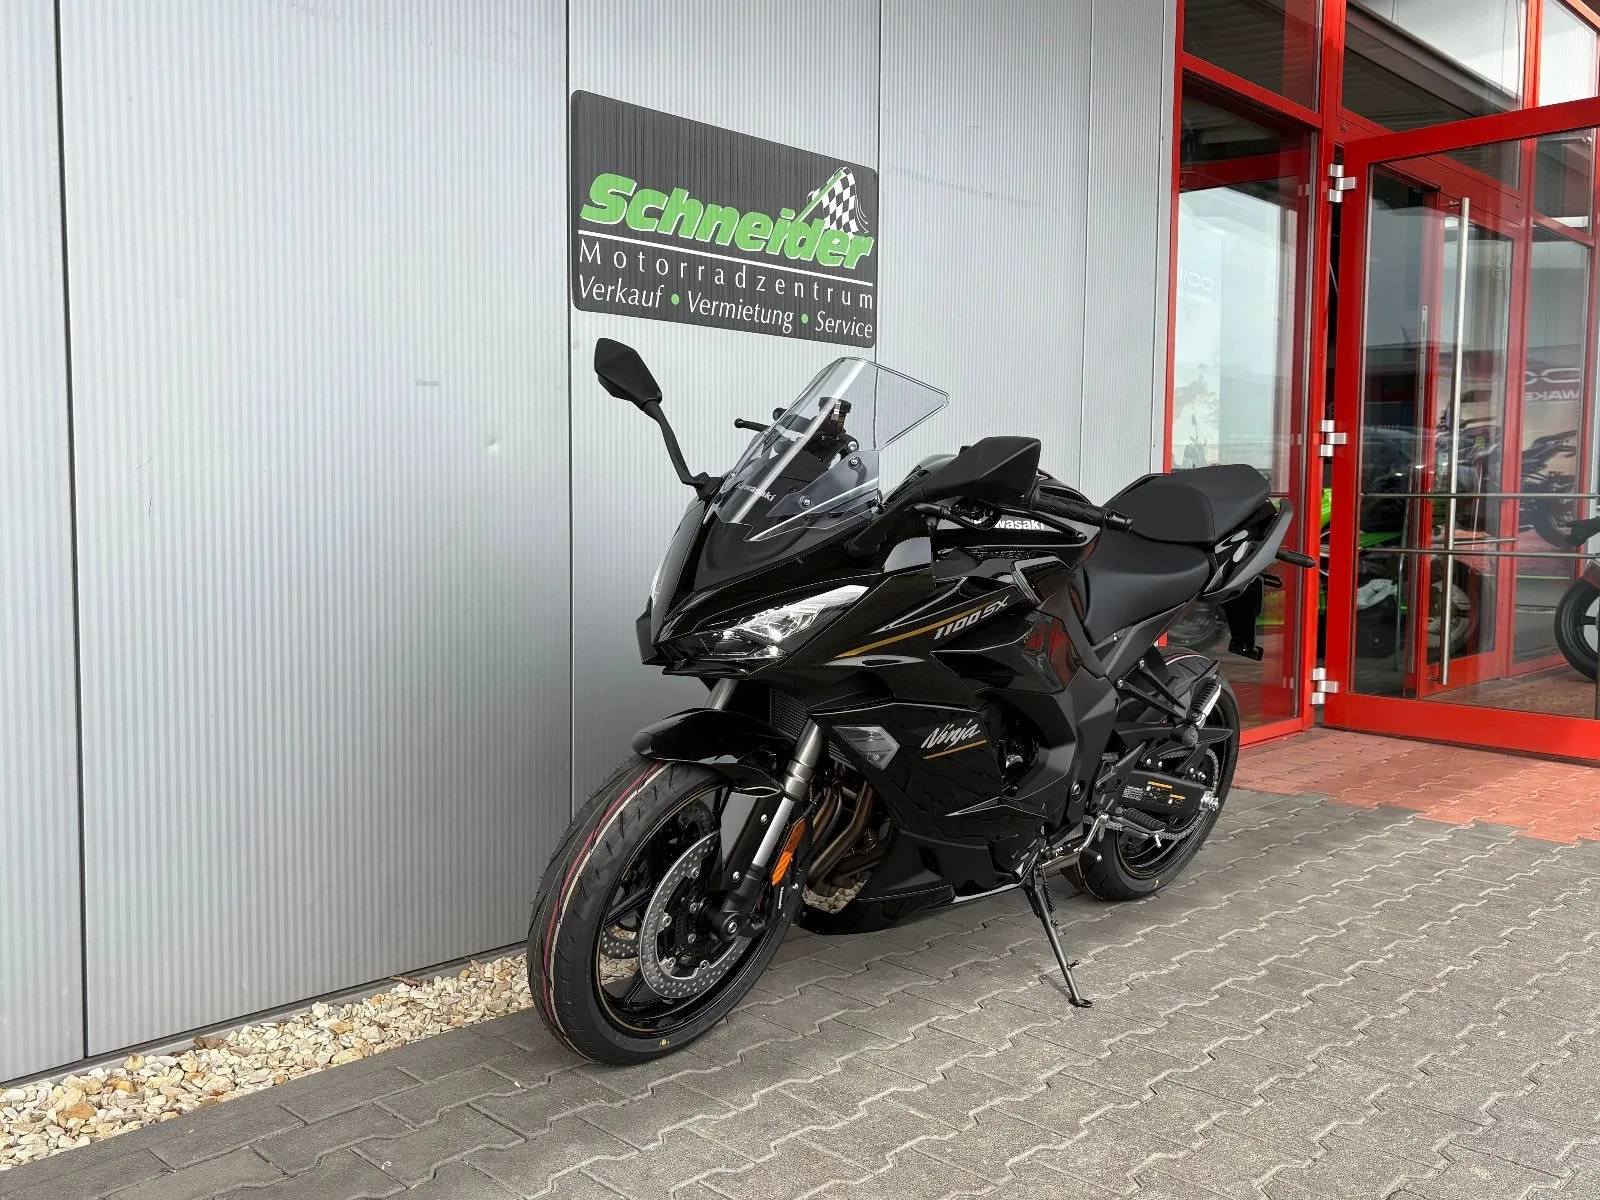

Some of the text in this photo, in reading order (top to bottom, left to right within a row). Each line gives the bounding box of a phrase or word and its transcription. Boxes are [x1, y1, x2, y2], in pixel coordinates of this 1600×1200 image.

[580, 172, 875, 270] Schneider
[579, 238, 874, 310] Motorradzentrum
[579, 274, 874, 339] Verkauf Vermietung Service
[974, 519, 1045, 530] wasaki
[920, 718, 981, 751] Ninja
